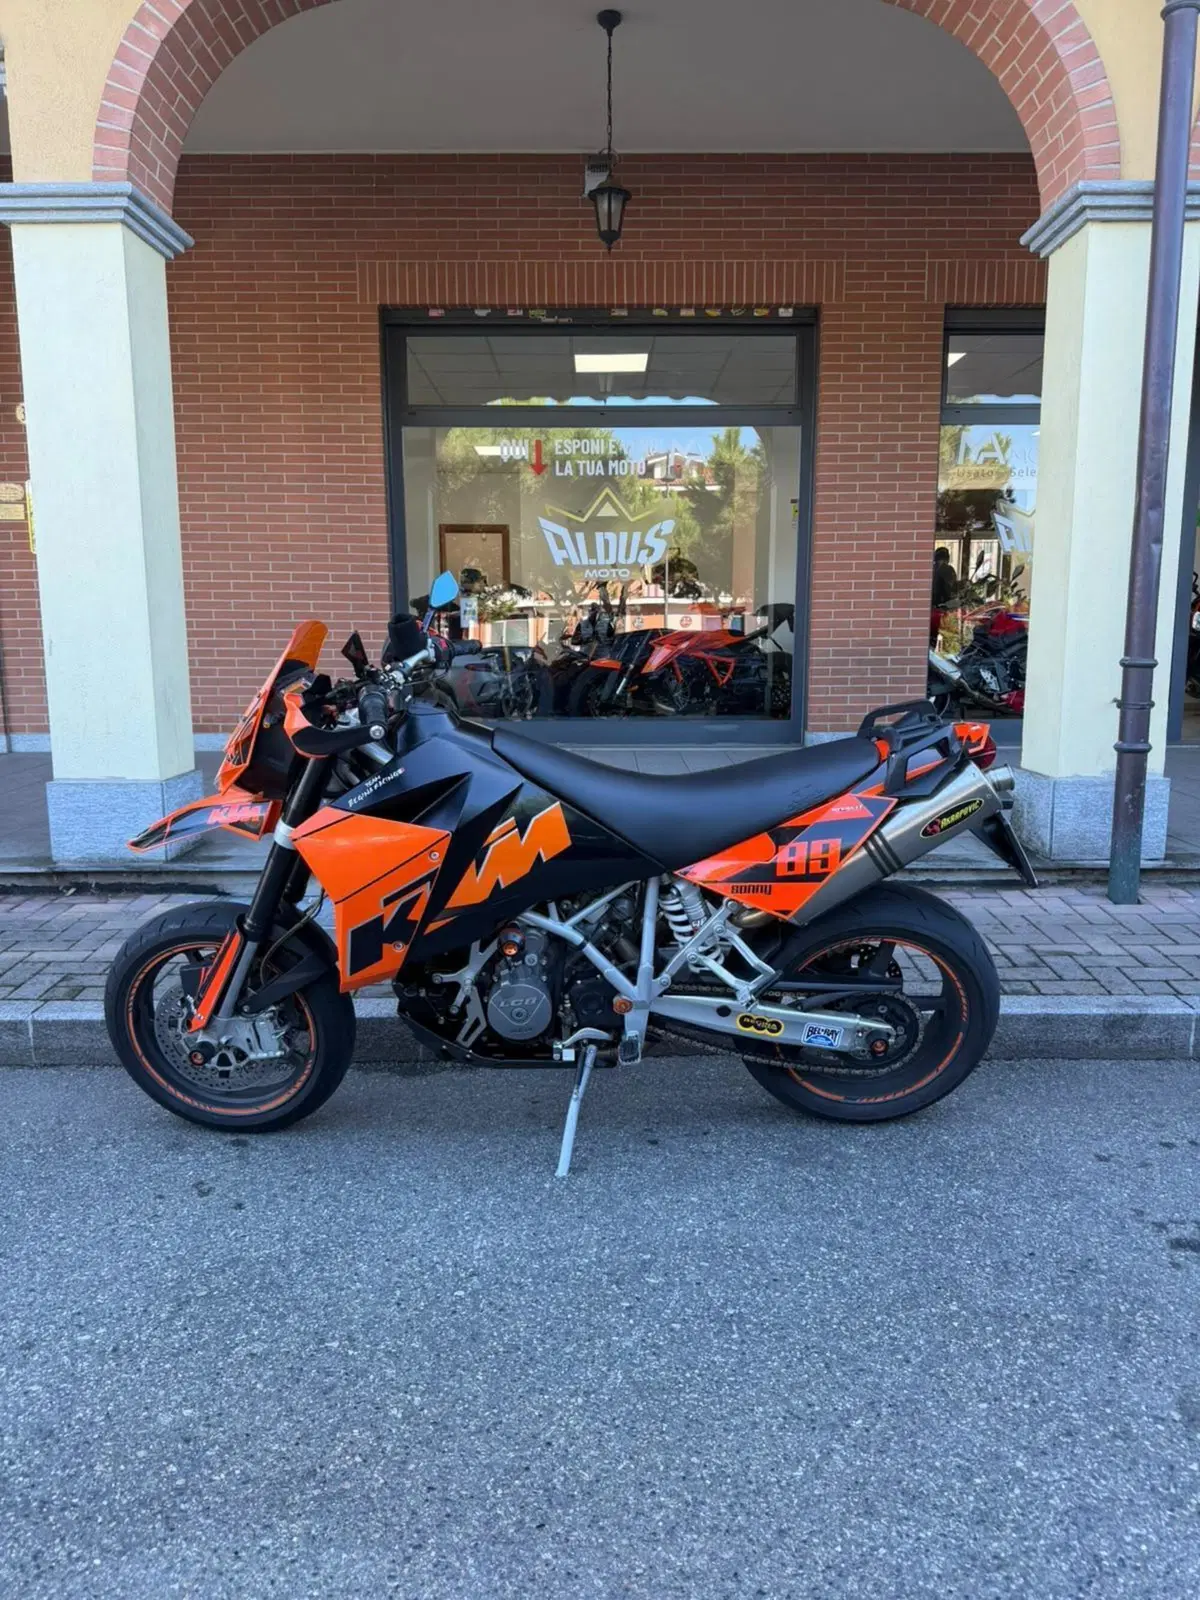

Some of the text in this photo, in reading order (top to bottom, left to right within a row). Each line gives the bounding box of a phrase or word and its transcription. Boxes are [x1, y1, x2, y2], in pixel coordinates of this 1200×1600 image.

[555, 439, 606, 455] ESPONI
[610, 439, 618, 455] E
[555, 460, 646, 476] LA TUA MOTO
[1010, 466, 1036, 478] Sele
[537, 516, 676, 567] ALDUS
[584, 568, 630, 578] MOTO
[206, 803, 263, 825] KTM
